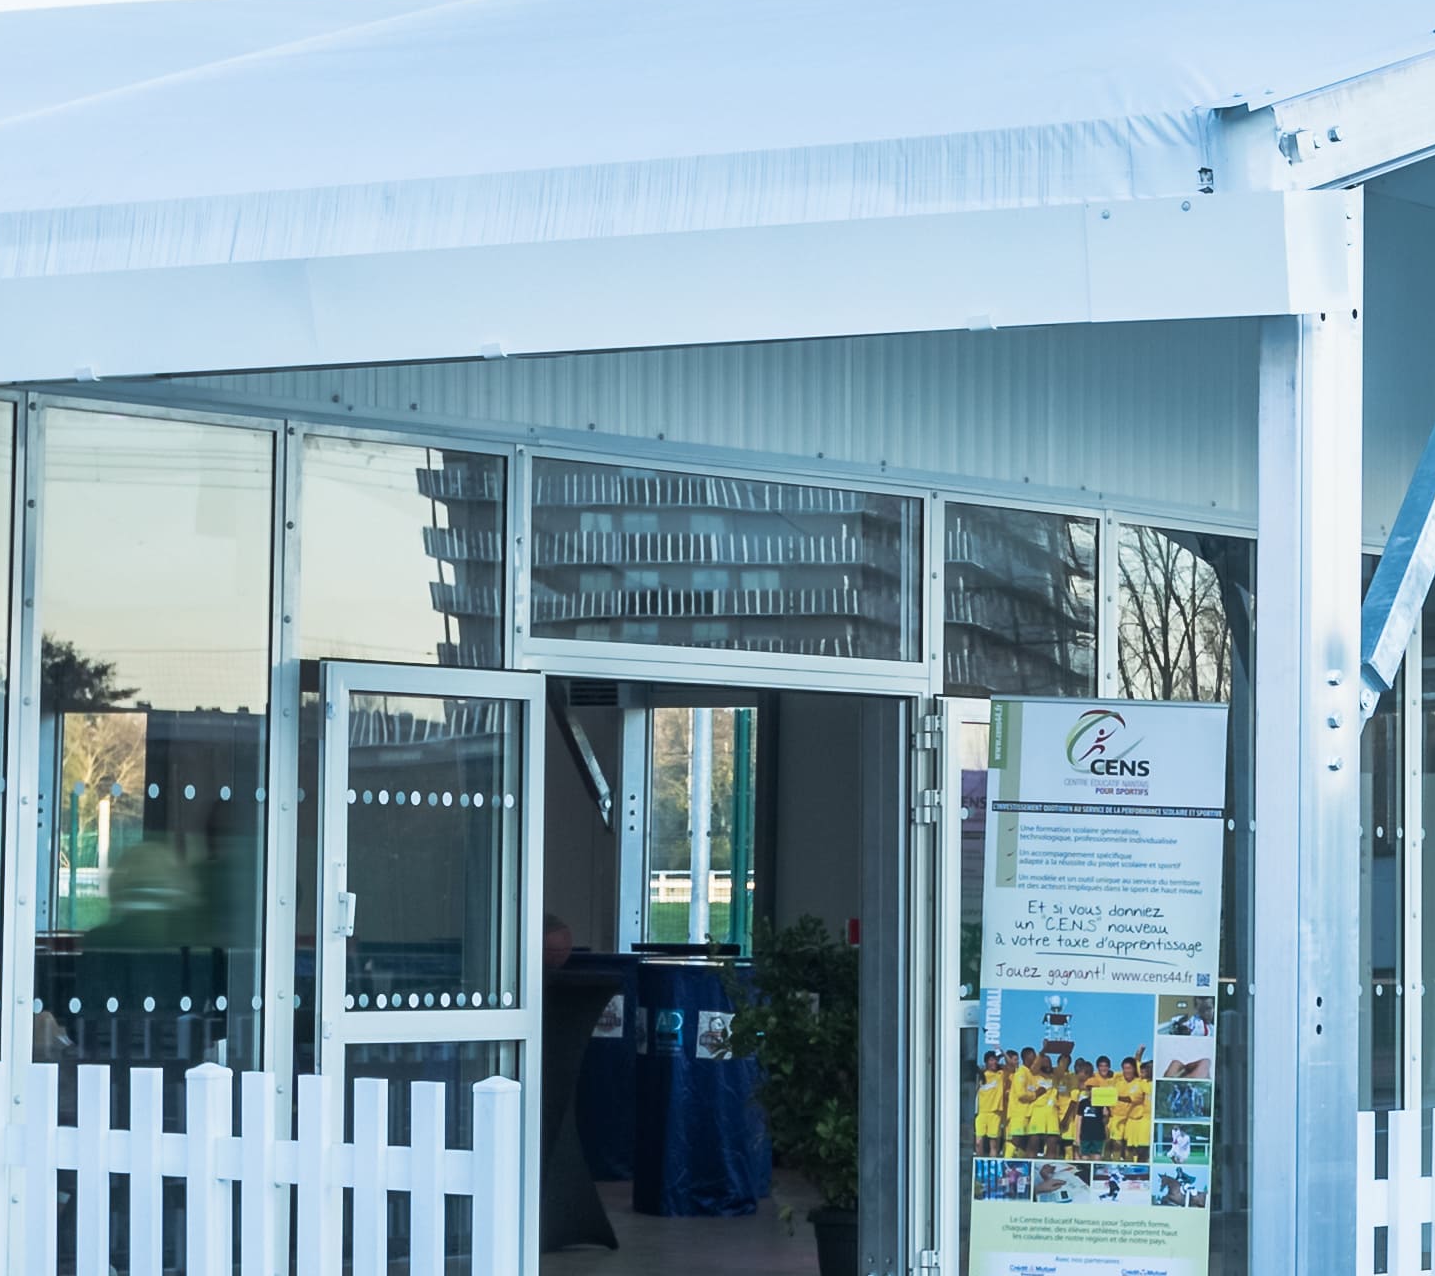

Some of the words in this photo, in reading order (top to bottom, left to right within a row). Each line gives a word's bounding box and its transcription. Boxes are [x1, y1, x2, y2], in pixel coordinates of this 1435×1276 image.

[1090, 759, 1150, 777] CENS
[1095, 787, 1114, 795] POUR
[1116, 788, 1149, 796] SPORTIFS
[1074, 805, 1082, 813] AU
[1082, 805, 1104, 813] SERVICE
[1105, 806, 1113, 814] DE
[1113, 806, 1121, 814] LA
[1188, 809, 1196, 817] ET
[1036, 825, 1070, 833] formation
[1072, 826, 1098, 834] scolaire
[1074, 834, 1127, 843] professionnelle
[1129, 836, 1178, 844] individualisée
[1031, 851, 1094, 859] accompagnement
[1097, 852, 1132, 860] spécifique
[1098, 860, 1119, 868] projet
[1121, 861, 1147, 869] scolaire
[1158, 862, 1181, 870] sportif
[1130, 886, 1148, 894] sport
[1179, 888, 1203, 896] niveau
[1028, 900, 1045, 914] Et
[1053, 903, 1063, 915] si
[1069, 905, 1102, 916] vous
[1108, 905, 1164, 918] donniez
[1015, 920, 1035, 930] un
[1108, 922, 1168, 934] nouveau
[995, 932, 1005, 945] à
[1011, 933, 1050, 947] votre
[1057, 935, 1090, 949] taxe
[1096, 936, 1203, 957] d'apprentissage
[995, 962, 1041, 978] Jouez
[1111, 971, 1193, 983] www.cens44.fr
[985, 988, 1002, 1044] FOOTBALL
[1002, 1224, 1028, 1232] chaque
